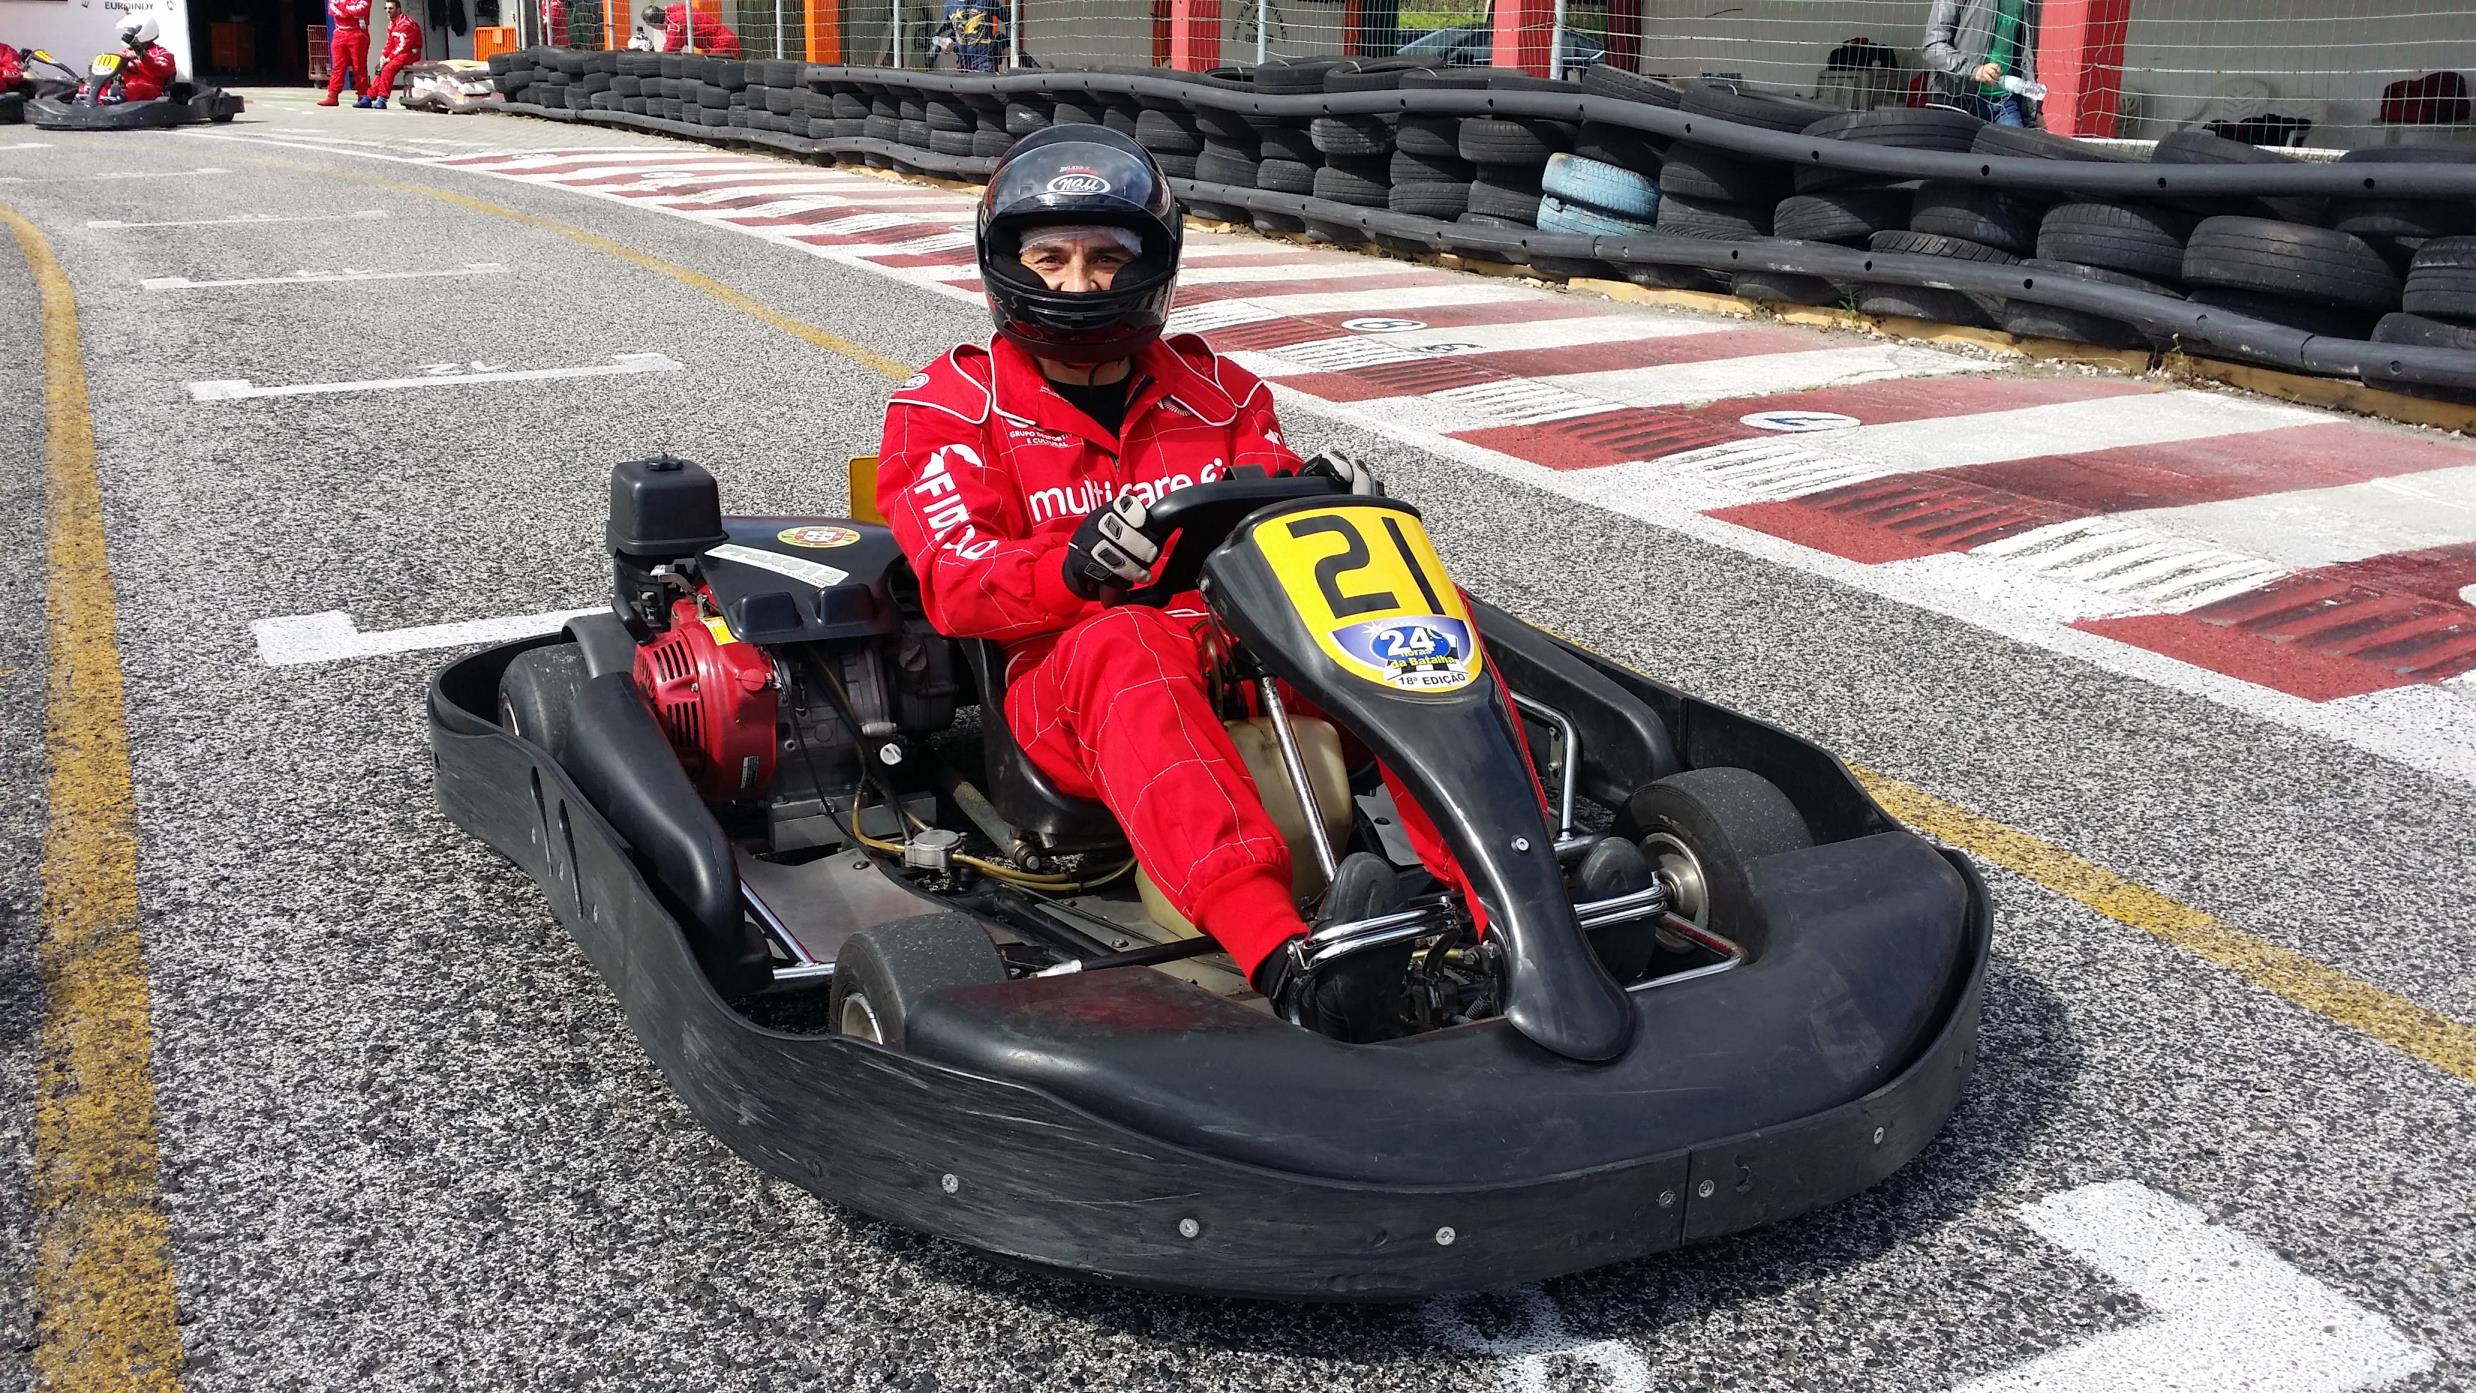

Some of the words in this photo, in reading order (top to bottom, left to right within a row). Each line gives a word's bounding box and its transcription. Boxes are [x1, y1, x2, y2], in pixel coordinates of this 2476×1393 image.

[1009, 430, 1035, 438] GRUPO
[1286, 514, 1446, 620] 21
[1390, 658, 1407, 669] da
[1408, 655, 1455, 667] Batalha
[1423, 672, 1466, 686] EDIÇÃO
